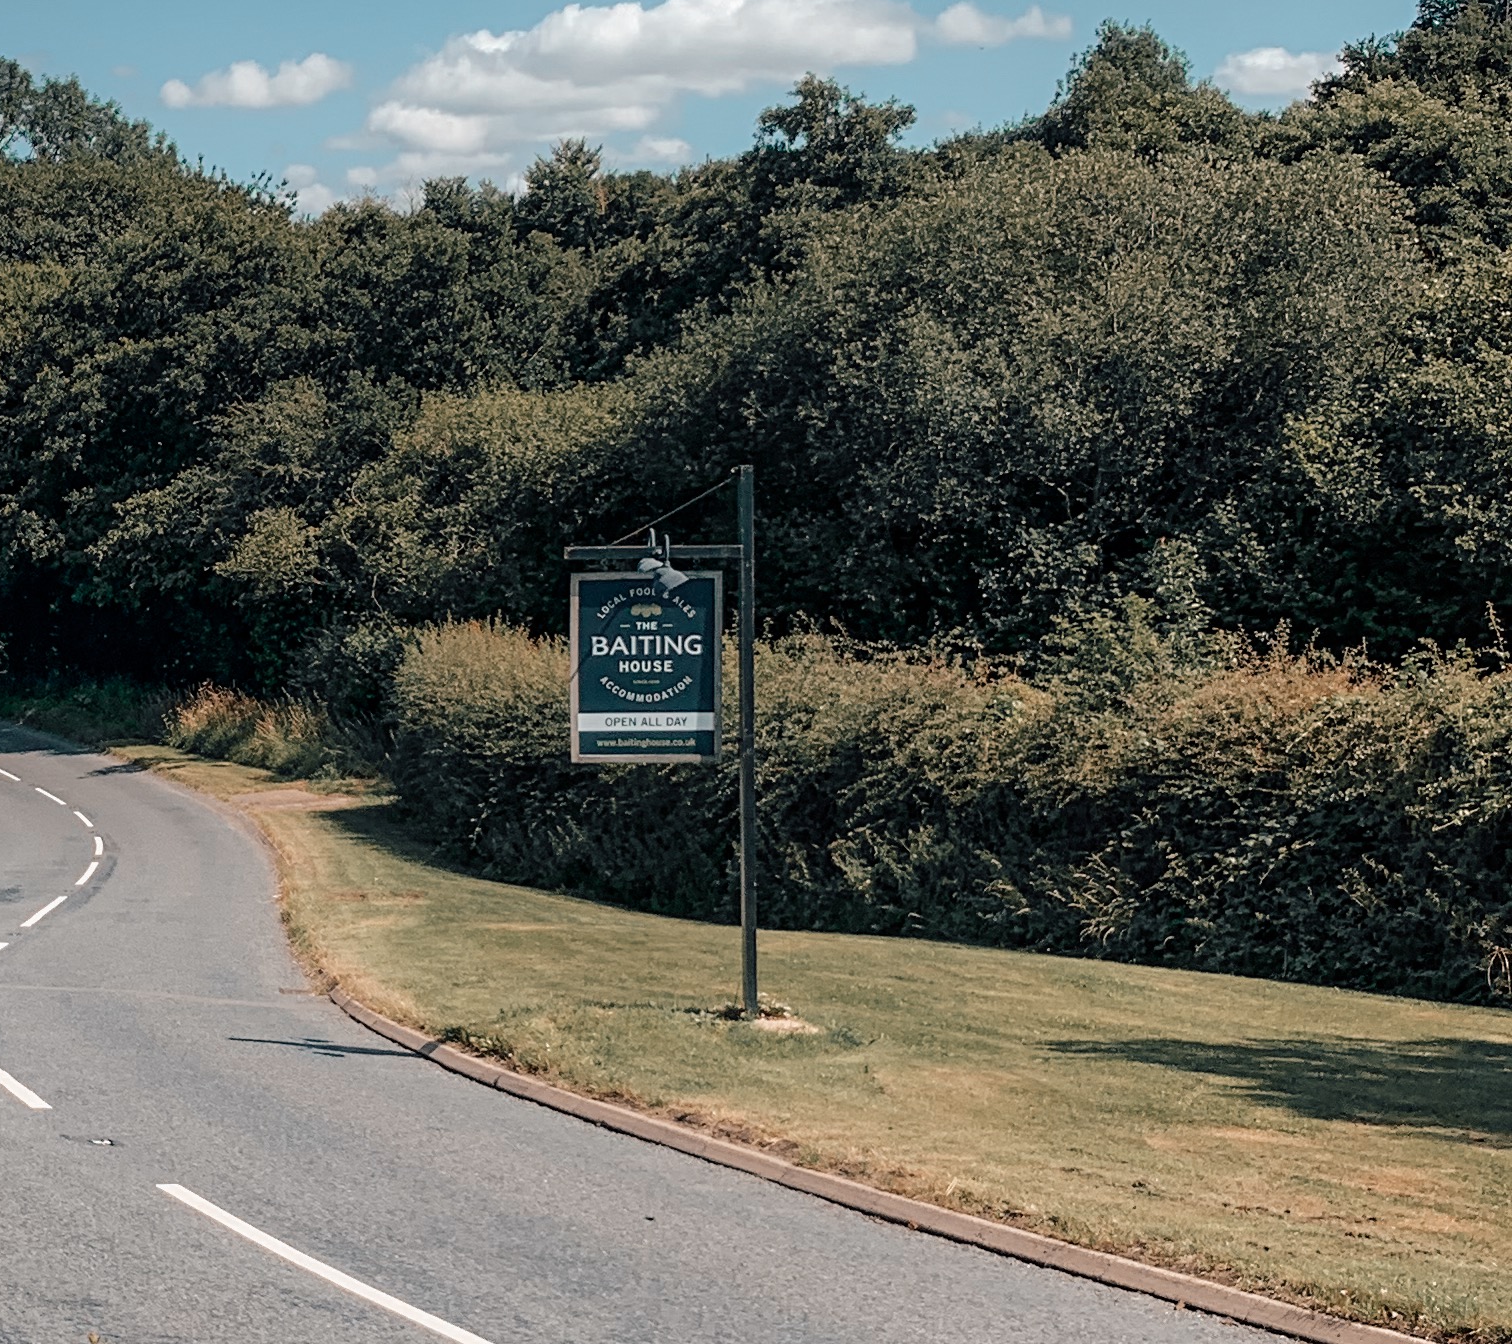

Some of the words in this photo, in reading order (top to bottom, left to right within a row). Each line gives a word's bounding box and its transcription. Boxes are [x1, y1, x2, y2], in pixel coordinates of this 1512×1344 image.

[597, 594, 627, 619] LOCAL
[672, 596, 696, 619] ALES
[636, 621, 658, 630] THE
[591, 635, 702, 656] BAITING
[619, 660, 673, 673] HOUSE
[599, 675, 693, 703] ACCOMMODATION
[605, 717, 637, 727] OPEN
[641, 717, 663, 727] ALL
[666, 717, 688, 727] DAY
[596, 738, 696, 748] www.baitinghouse.co.uk
